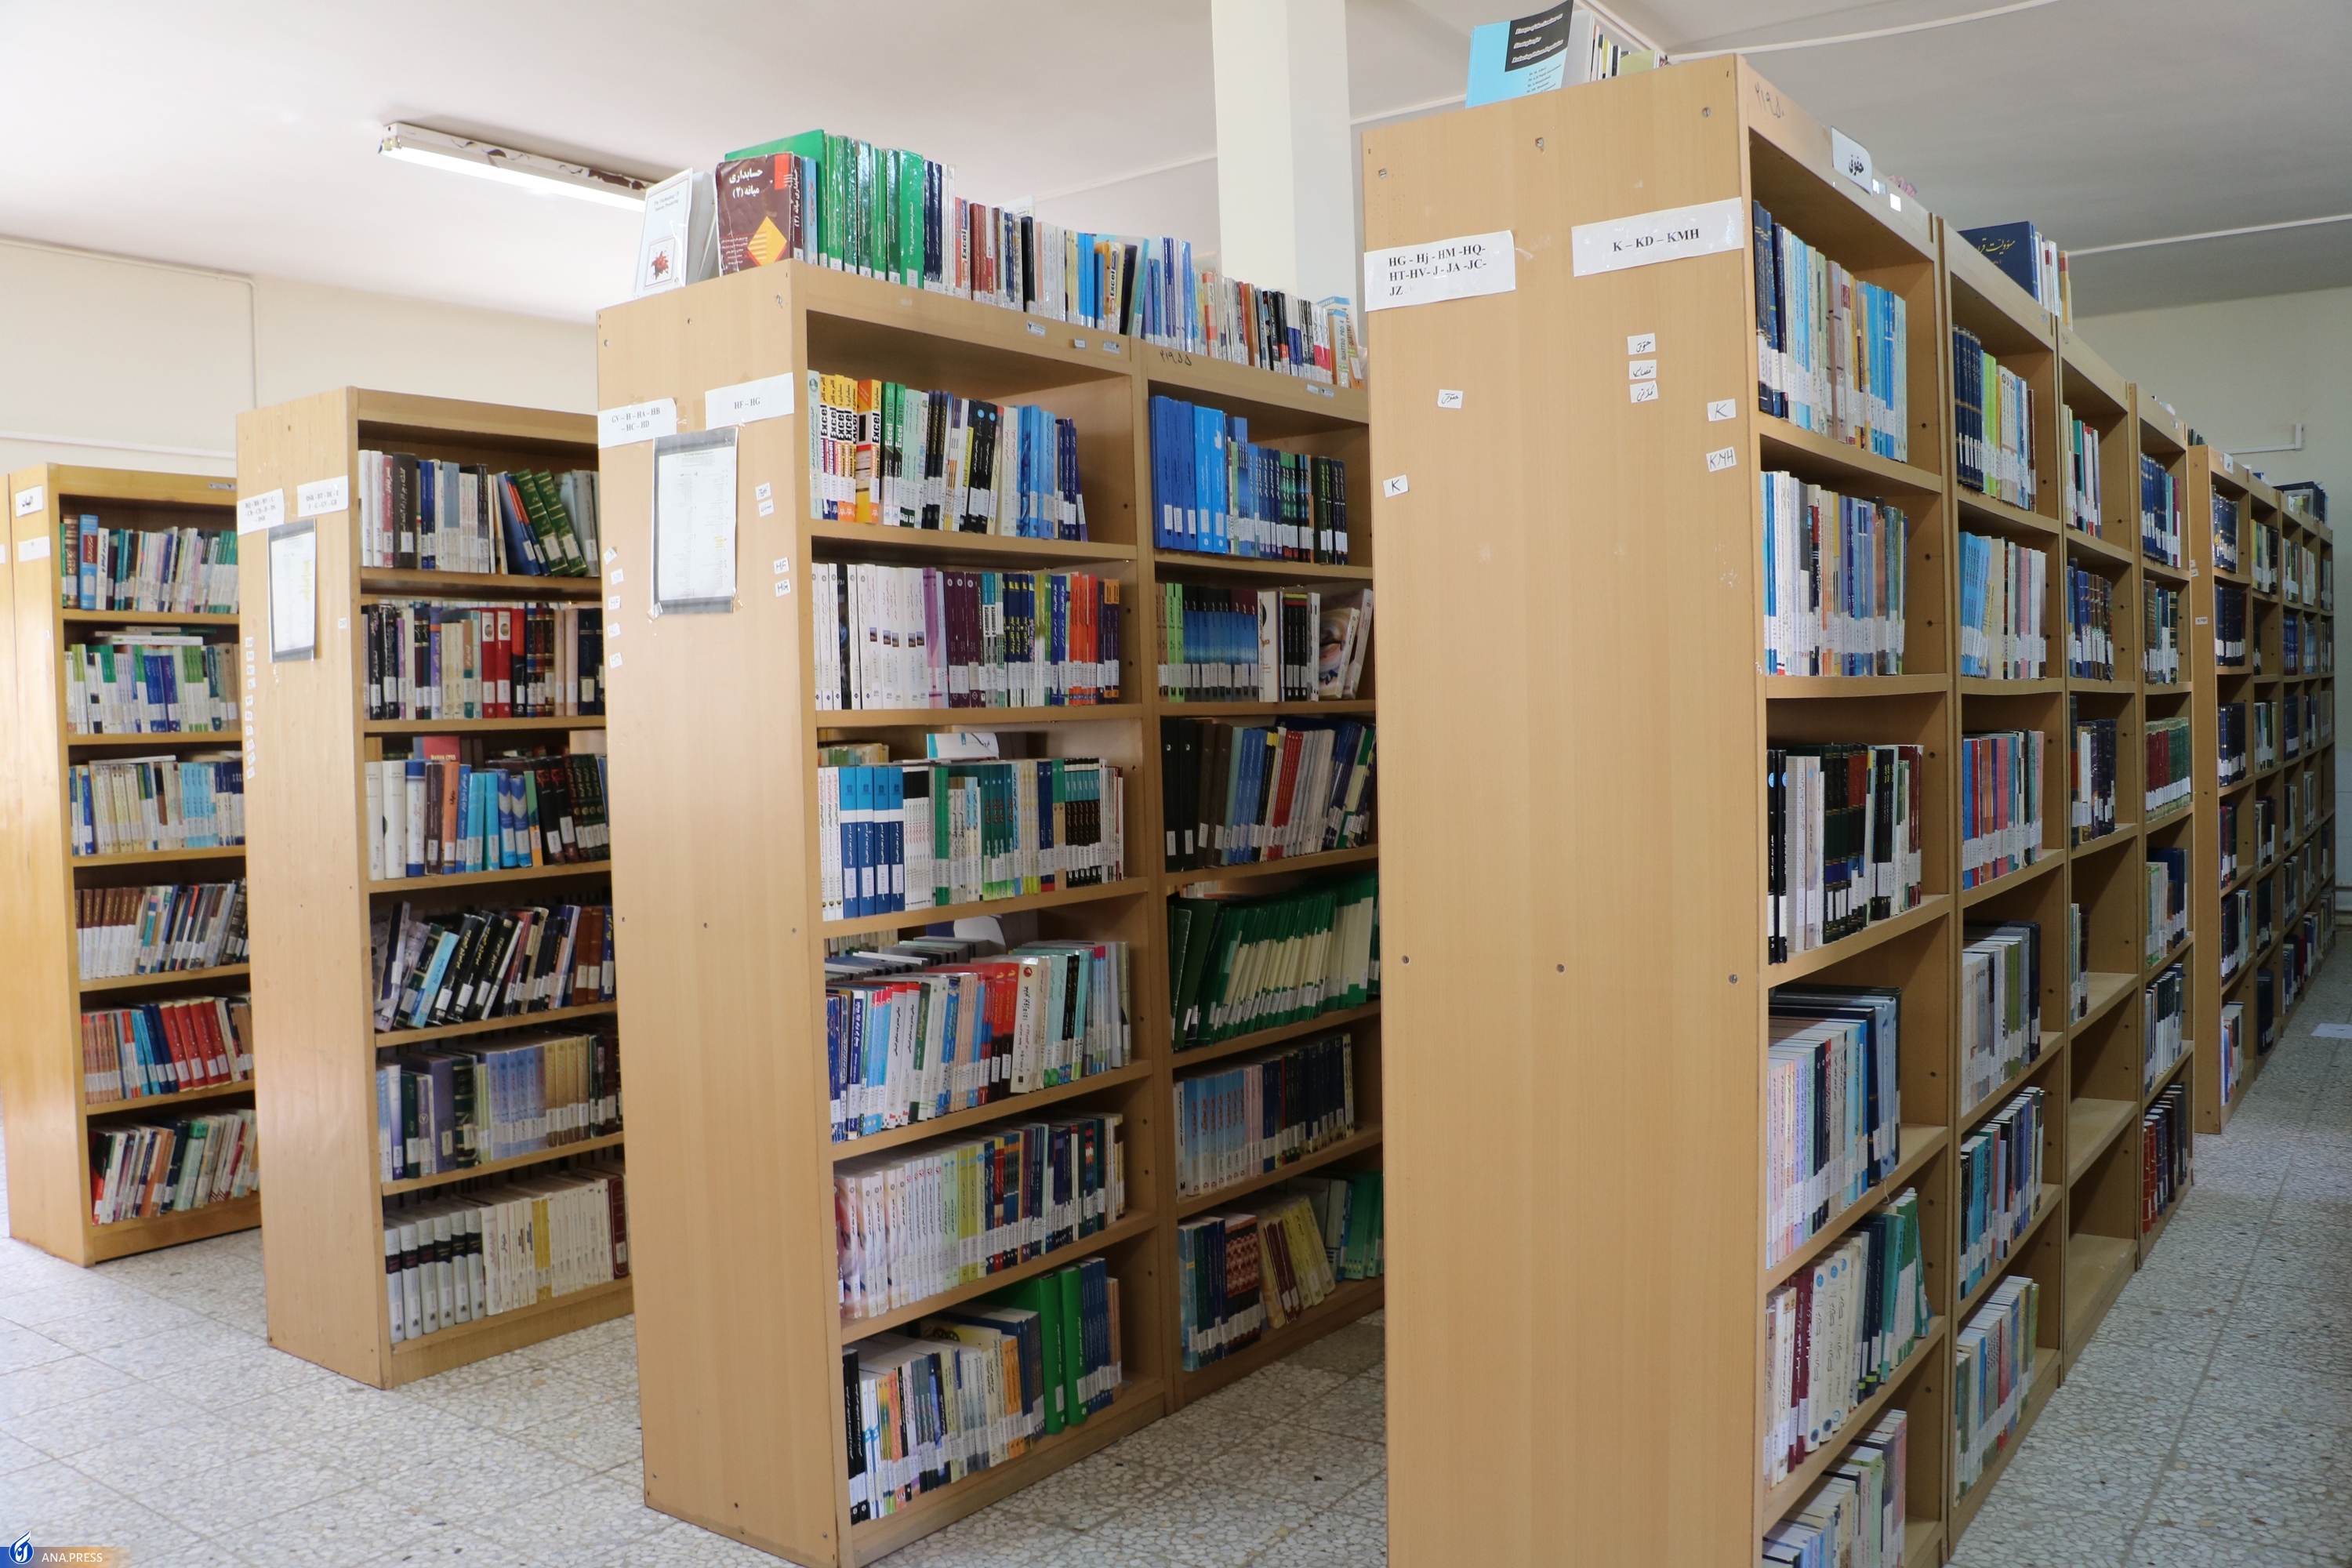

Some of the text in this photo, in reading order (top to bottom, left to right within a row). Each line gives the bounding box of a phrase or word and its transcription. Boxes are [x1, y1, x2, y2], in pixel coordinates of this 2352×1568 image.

[728, 168, 763, 184] حسابداری
[792, 168, 800, 199] حسابداری
[732, 186, 760, 198] میانه (۲)
[1613, 228, 1700, 252] K KD KMH
[1388, 256, 1406, 267] HG
[1416, 252, 1428, 266] Hj
[1438, 248, 1456, 260] HM
[1433, 265, 1439, 276] J
[1446, 263, 1460, 274] JA
[1389, 285, 1403, 296] JZ
[734, 401, 743, 409] HF
[1715, 404, 1728, 418] K
[837, 410, 845, 441] Excel
[844, 410, 853, 441] Excel
[1710, 450, 1733, 467] KMH
[1391, 479, 1401, 492] K
[775, 560, 786, 571] HF
[778, 581, 788, 591] HG
